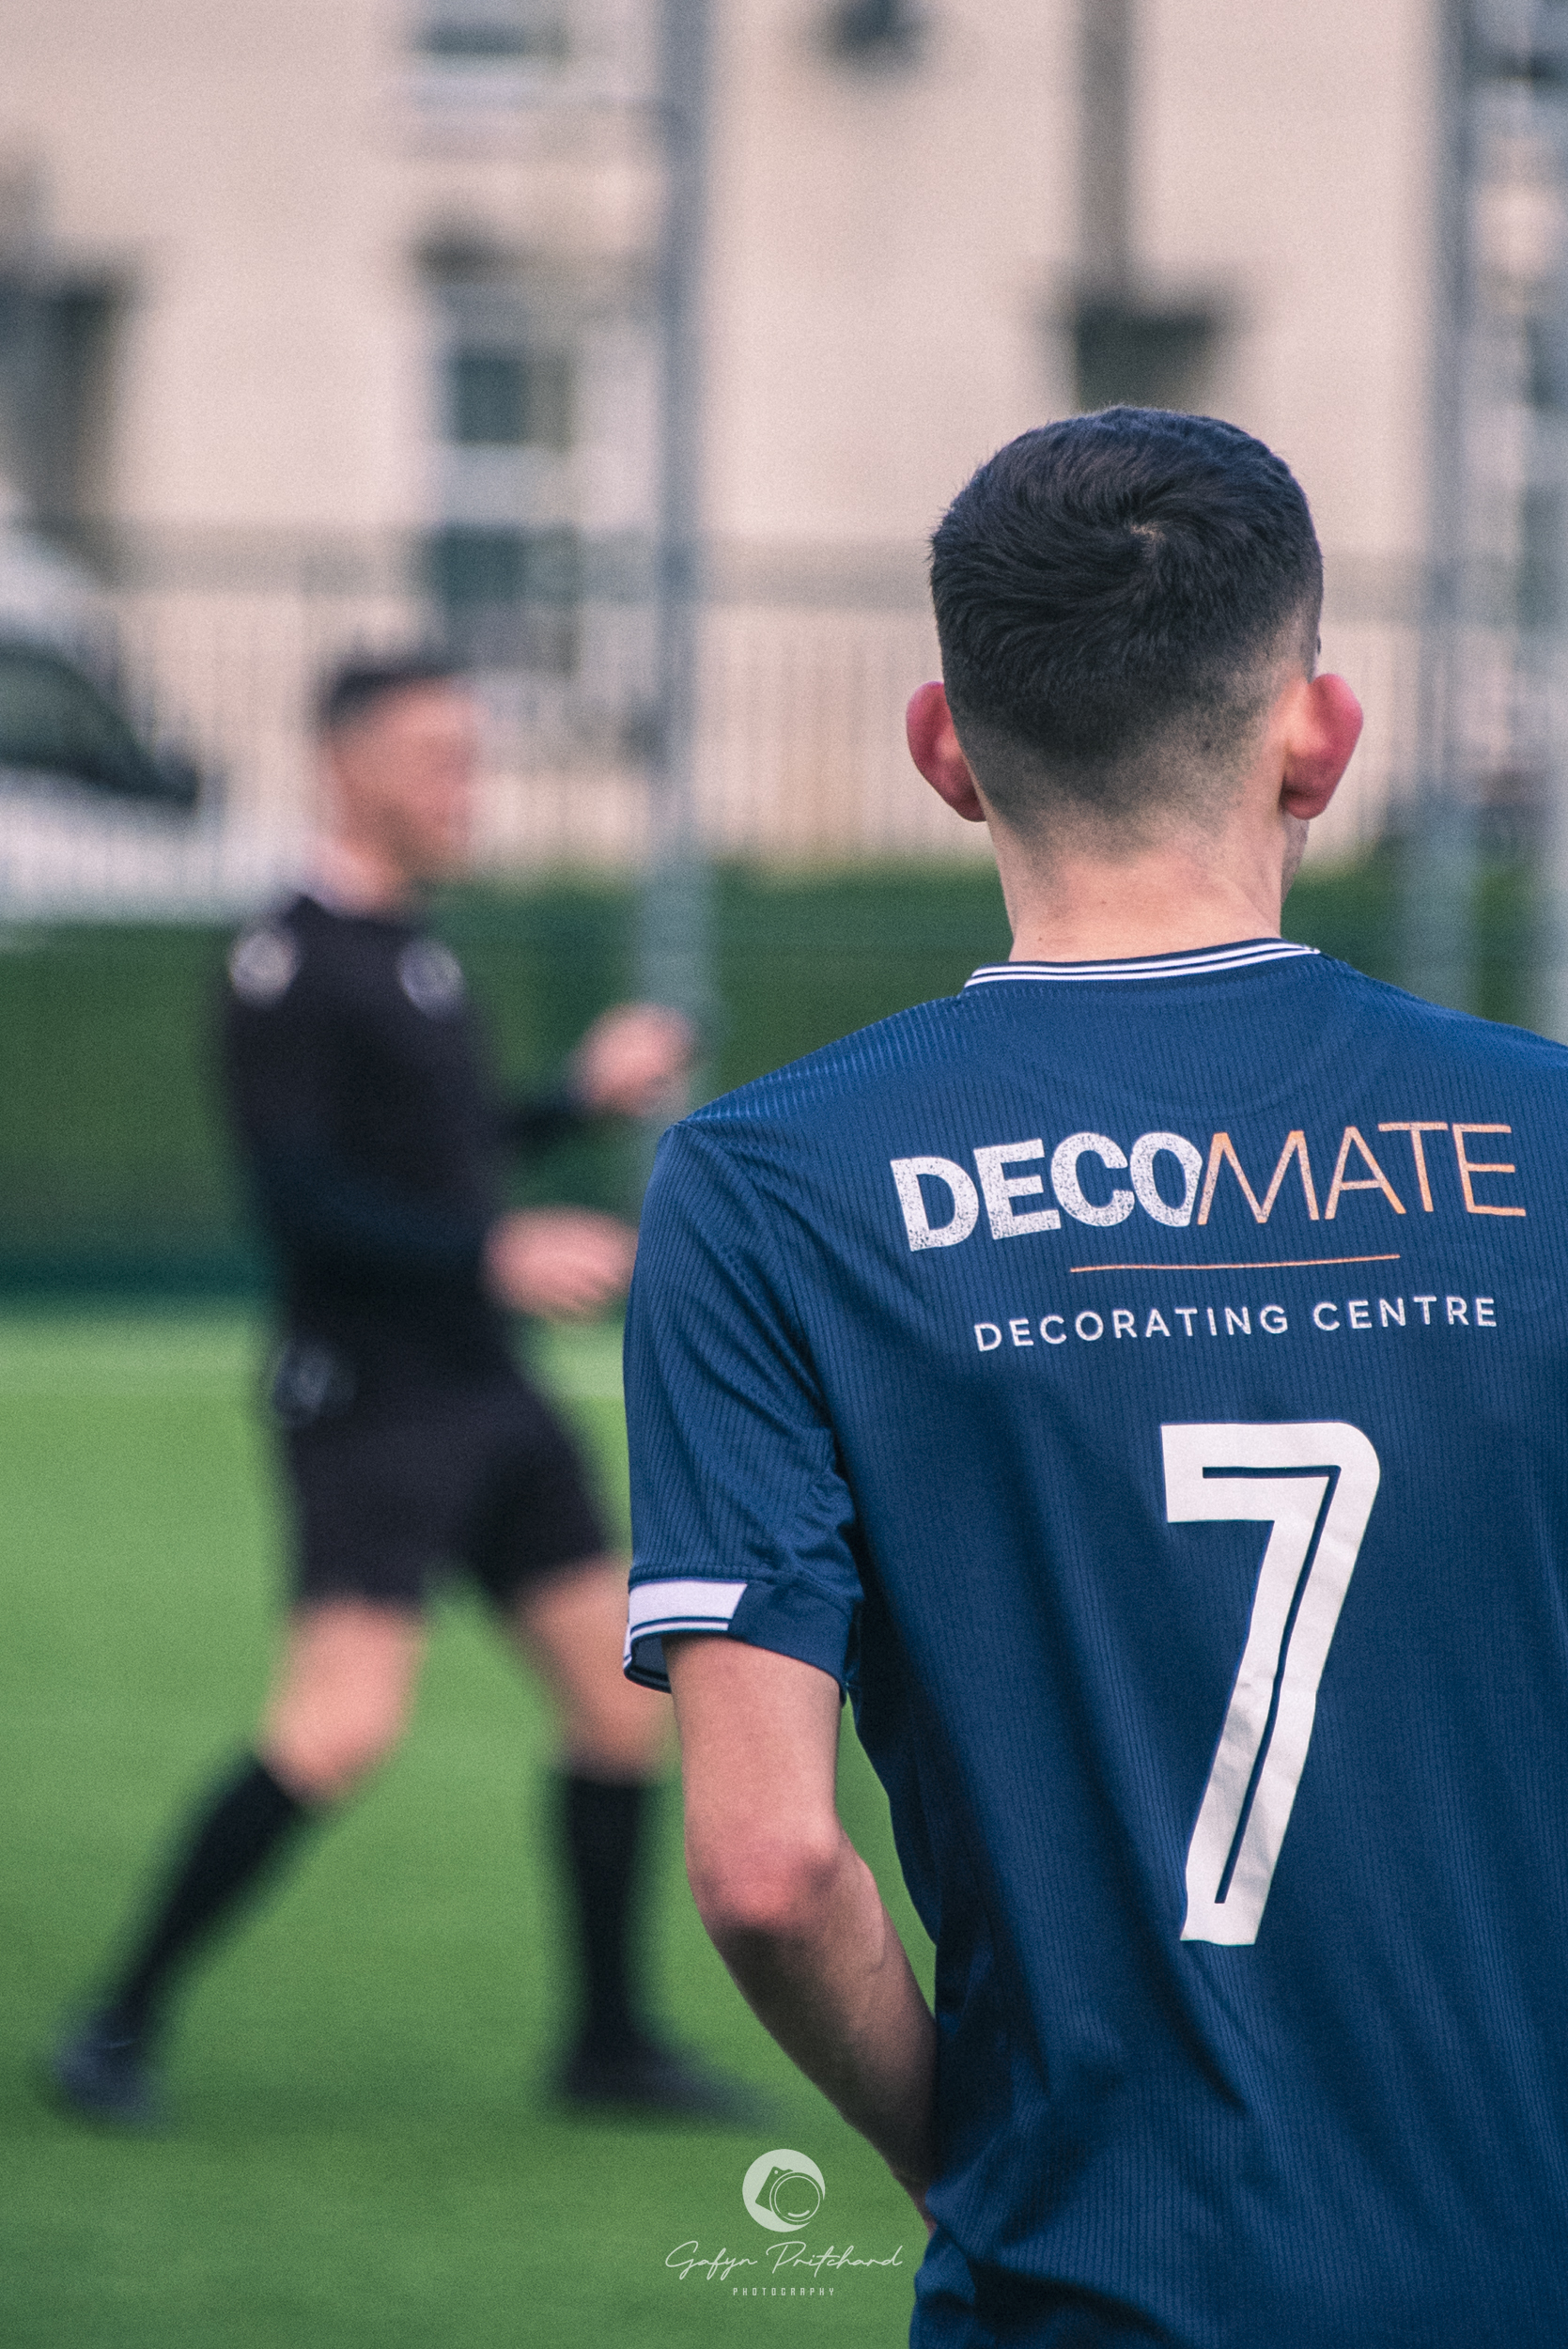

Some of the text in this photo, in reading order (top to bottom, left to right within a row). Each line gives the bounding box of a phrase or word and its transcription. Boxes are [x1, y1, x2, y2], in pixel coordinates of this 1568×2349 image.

[890, 1122, 1528, 1252] DECOMATE
[974, 1296, 1498, 1352] DECORATING CENTRE
[1161, 1422, 1381, 1946] 7
